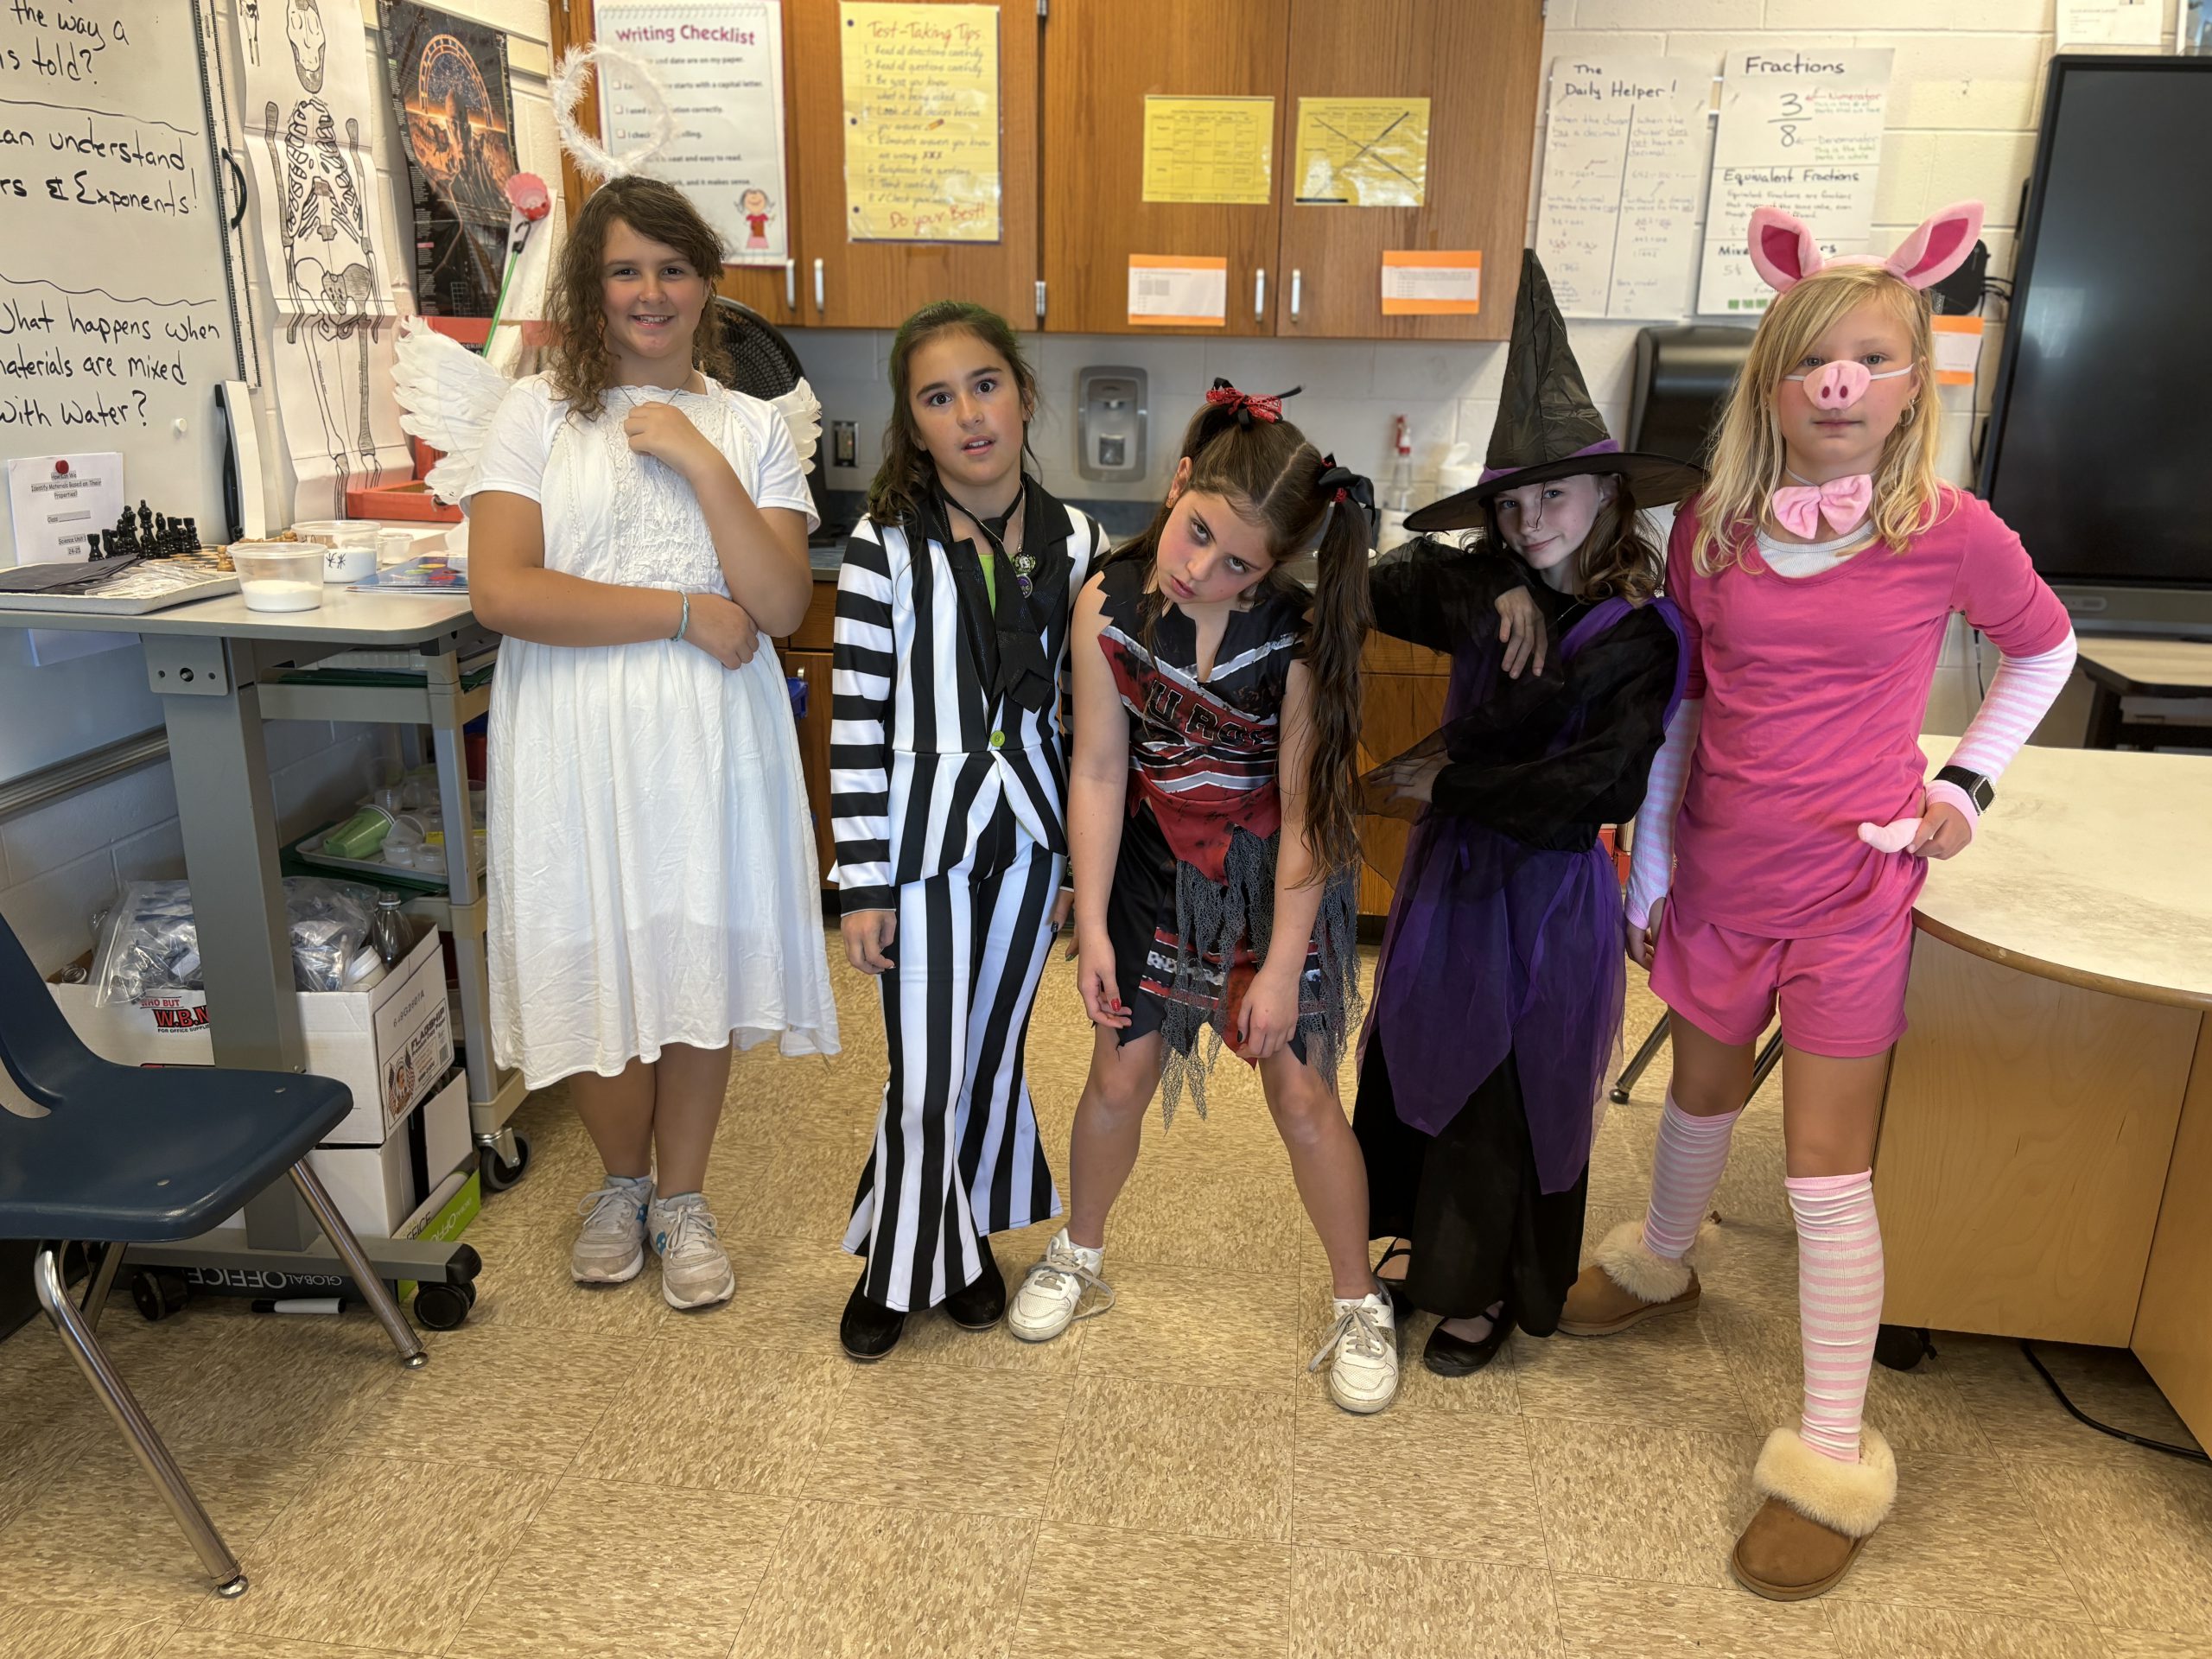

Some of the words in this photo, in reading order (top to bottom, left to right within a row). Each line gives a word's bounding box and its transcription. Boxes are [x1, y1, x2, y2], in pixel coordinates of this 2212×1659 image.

[10, 0, 48, 27] the
[57, 12, 105, 51] way
[113, 21, 130, 45] a
[615, 26, 675, 43] Writing
[680, 24, 755, 45] Checklist
[868, 21, 951, 48] Test-Taking
[954, 23, 982, 46] Tips
[31, 36, 98, 85] told?
[1573, 64, 1602, 75] The
[1745, 53, 1845, 74] Fractions
[1565, 81, 1601, 100] Daily
[1780, 93, 1802, 116] 3
[0, 130, 34, 146] an
[49, 117, 185, 171] understand
[1780, 124, 1796, 148] 8
[1724, 168, 1794, 186] Equivalent
[1803, 168, 1859, 181] Fractions
[74, 168, 198, 217] Exponents!
[1719, 245, 1749, 256] Mixe
[67, 296, 152, 345] happens
[0, 342, 73, 380] aterials
[83, 355, 117, 378] are
[127, 350, 188, 385] mixed
[410, 1006, 446, 1051] FLAGSHIP
